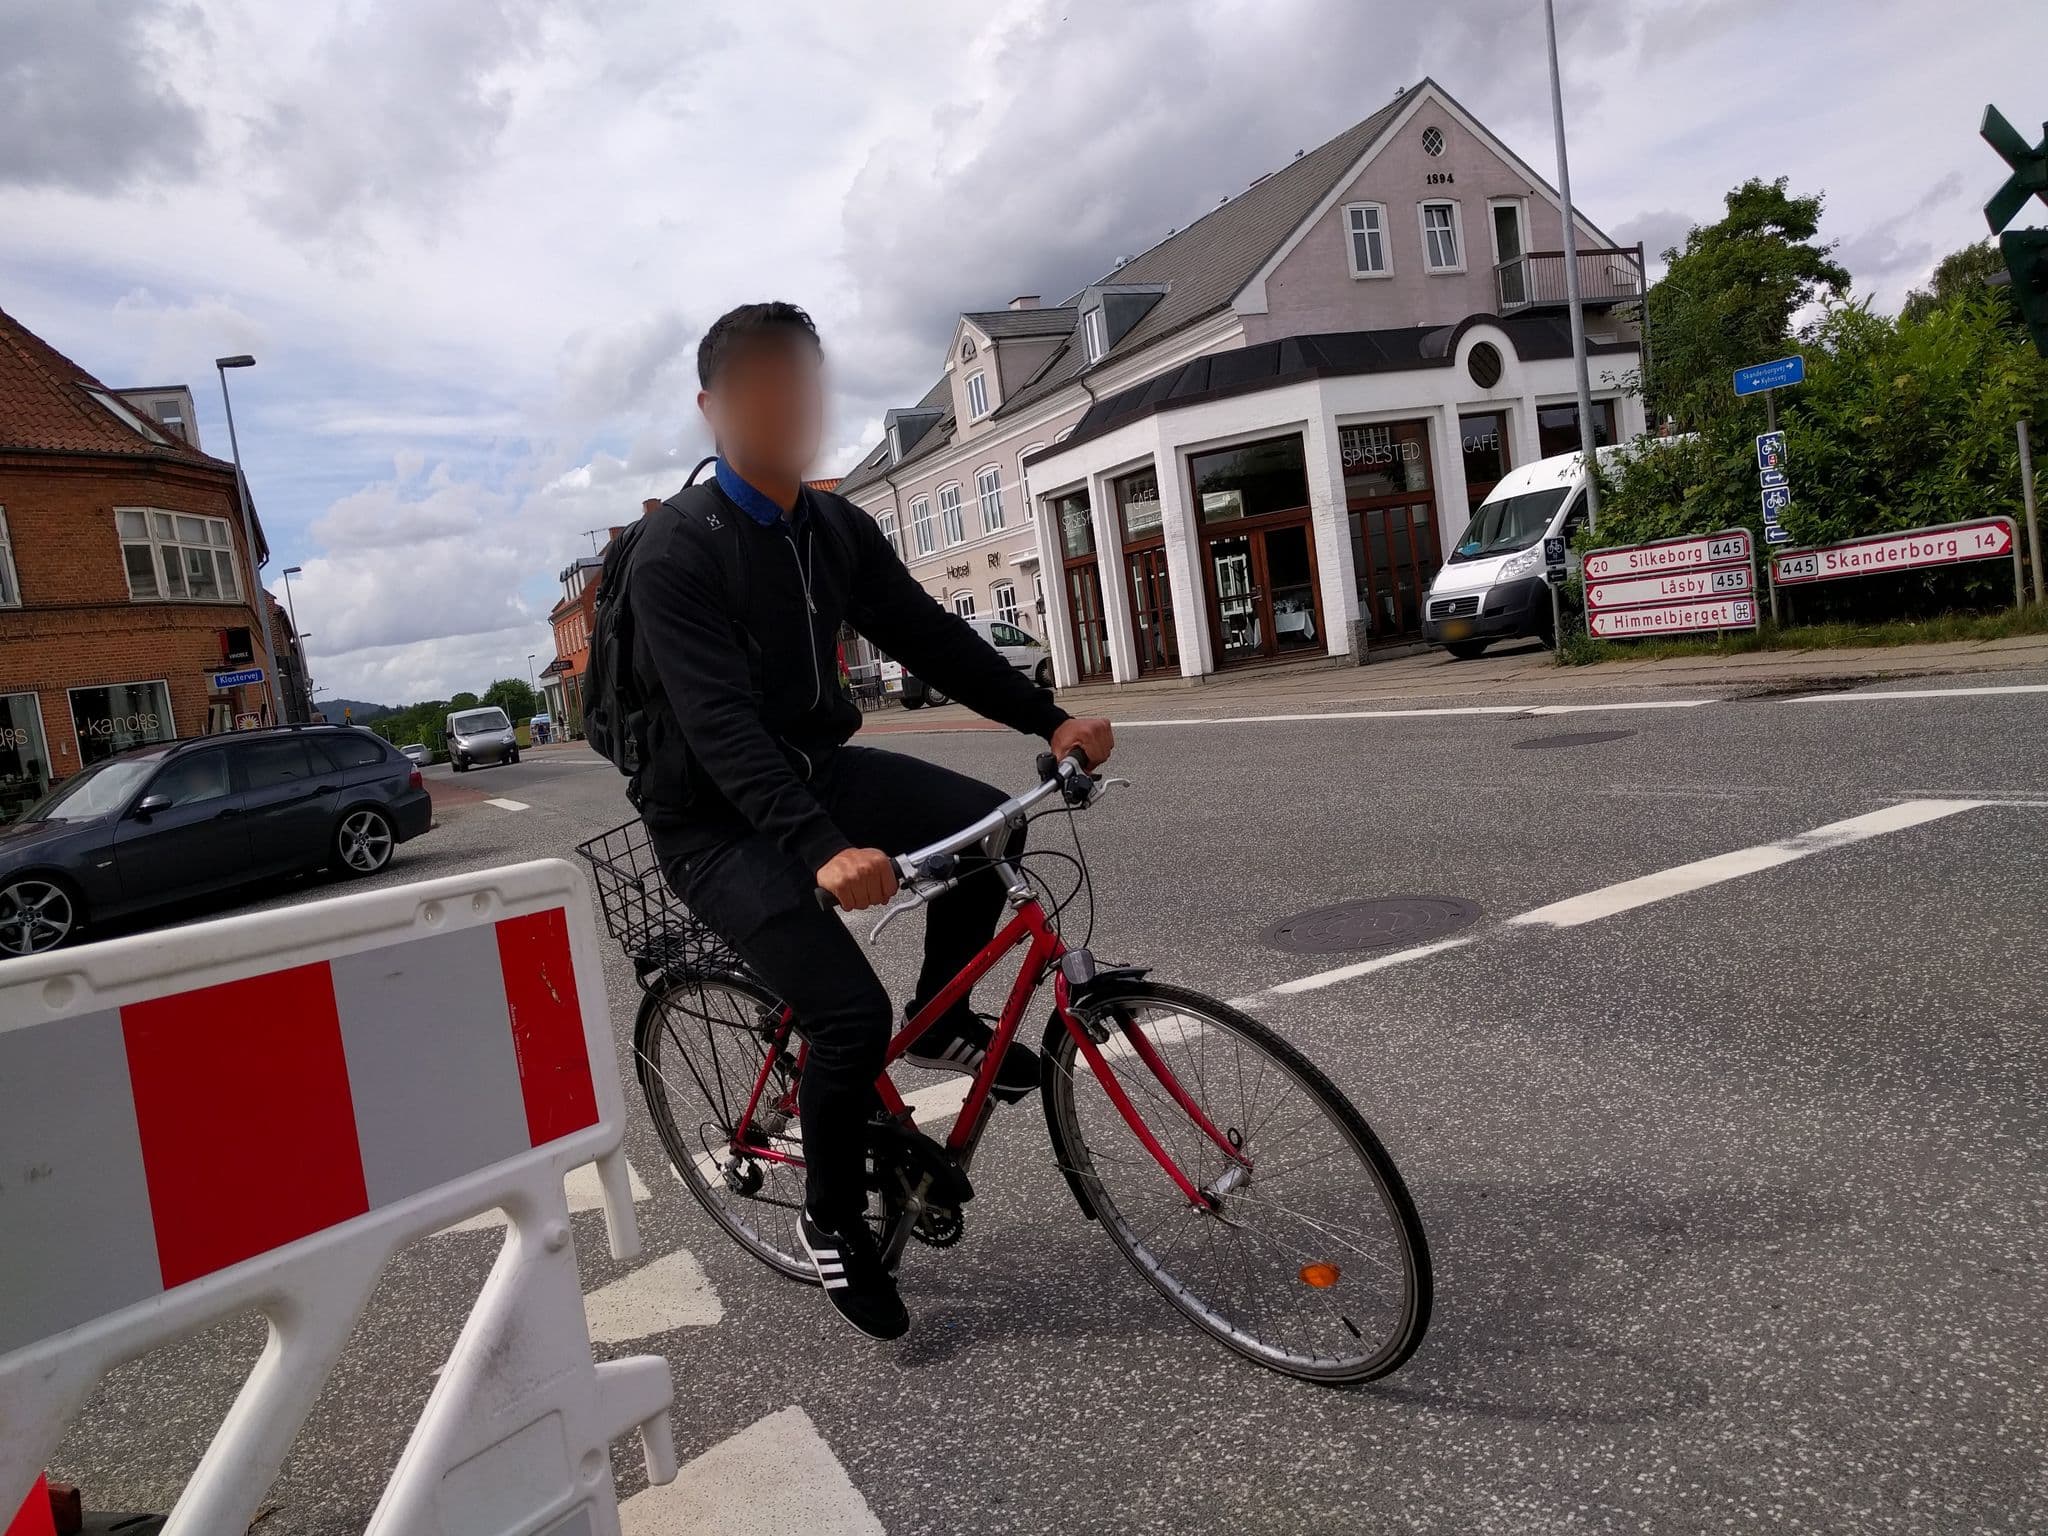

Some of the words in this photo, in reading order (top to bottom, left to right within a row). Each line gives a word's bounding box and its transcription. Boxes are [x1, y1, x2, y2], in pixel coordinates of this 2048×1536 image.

[1426, 173, 1454, 185] 1894
[1342, 441, 1421, 468] SPISESTED
[1462, 432, 1500, 454] CAFE
[1132, 487, 1155, 511] CAFE
[1593, 561, 1609, 574] 20
[1629, 548, 1702, 568] Silkeborg
[1712, 541, 1741, 556] 445
[1781, 559, 1814, 576] 445
[1825, 540, 1958, 570] Skanderborg
[1974, 533, 1996, 549] 14
[1595, 590, 1603, 601] 9
[1660, 577, 1705, 595] Låsby
[1716, 573, 1744, 588] 455
[1599, 618, 1605, 630] 7
[1614, 606, 1728, 629] Himmelbjerget
[220, 672, 259, 684] Klostervej
